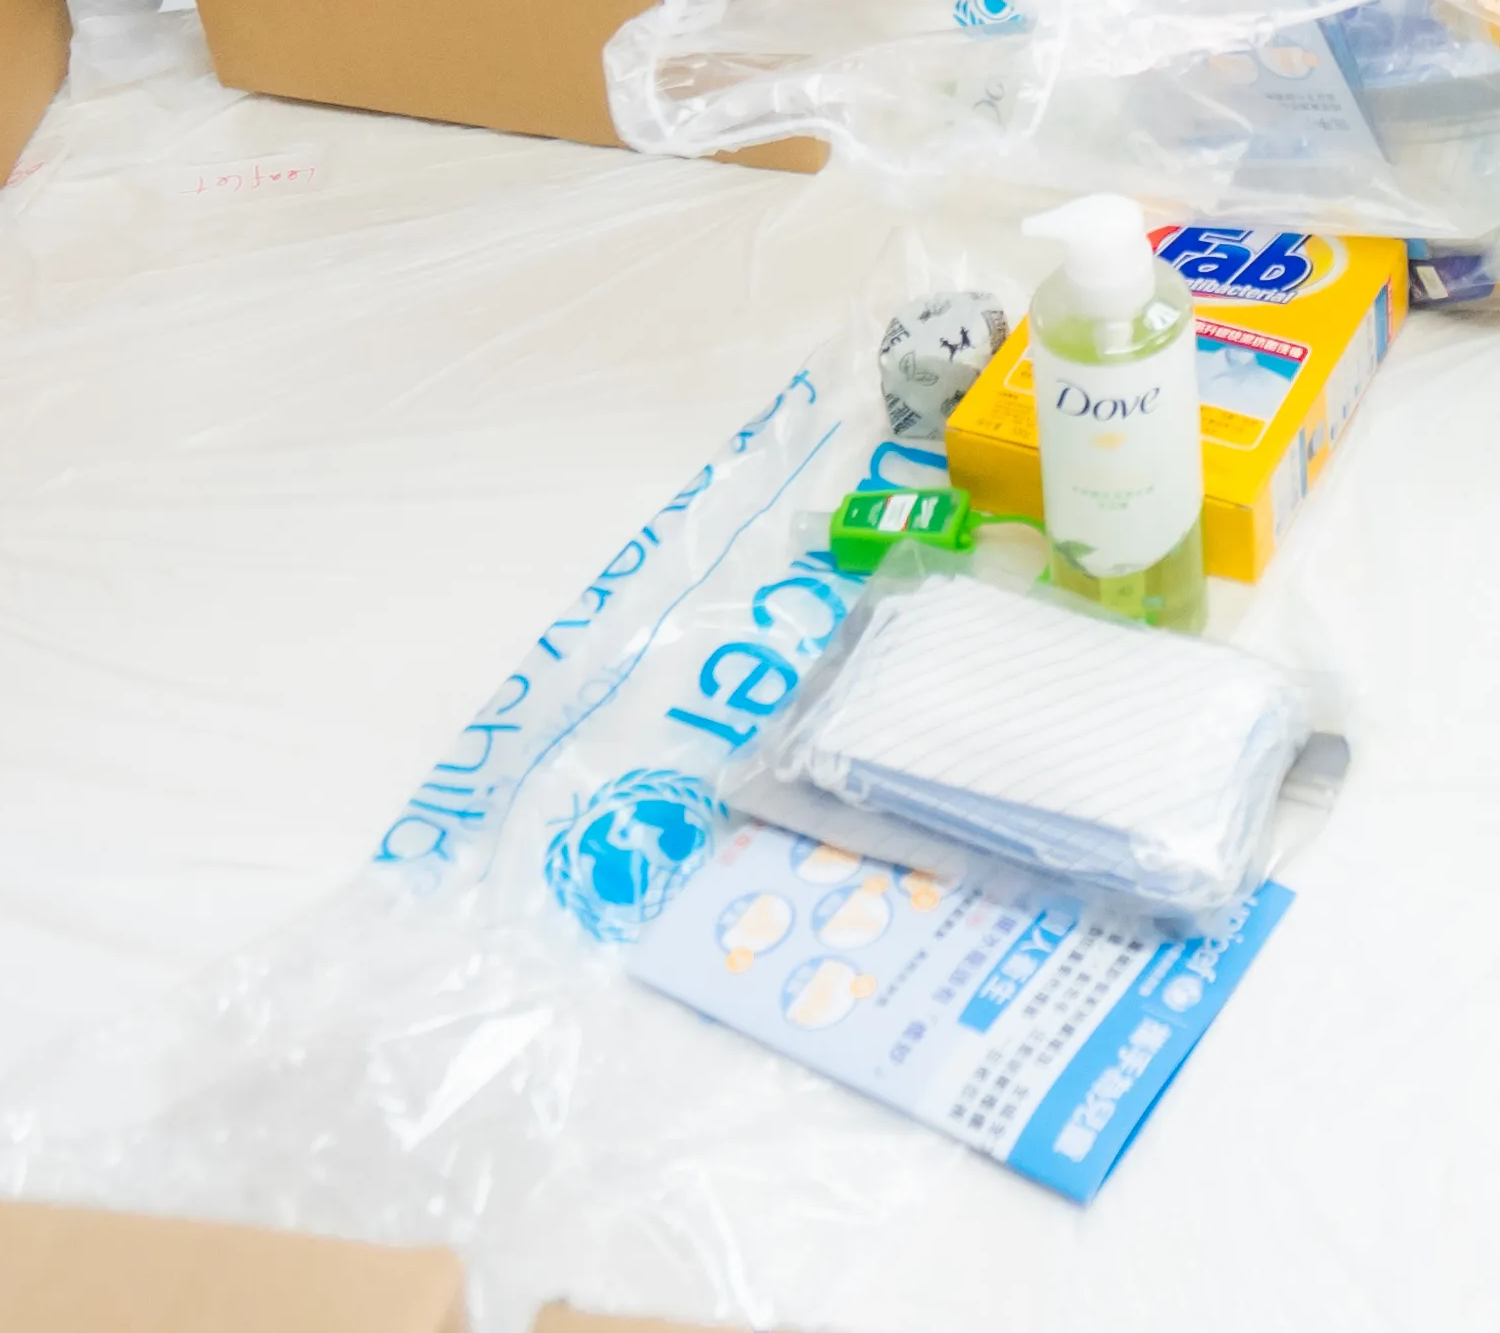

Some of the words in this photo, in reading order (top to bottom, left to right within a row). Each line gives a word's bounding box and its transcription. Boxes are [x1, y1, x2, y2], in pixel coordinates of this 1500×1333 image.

[1156, 225, 1313, 295] Fab
[1188, 276, 1298, 305] ntibacterial
[1055, 379, 1160, 422] Dove
[665, 441, 948, 757] uicef
